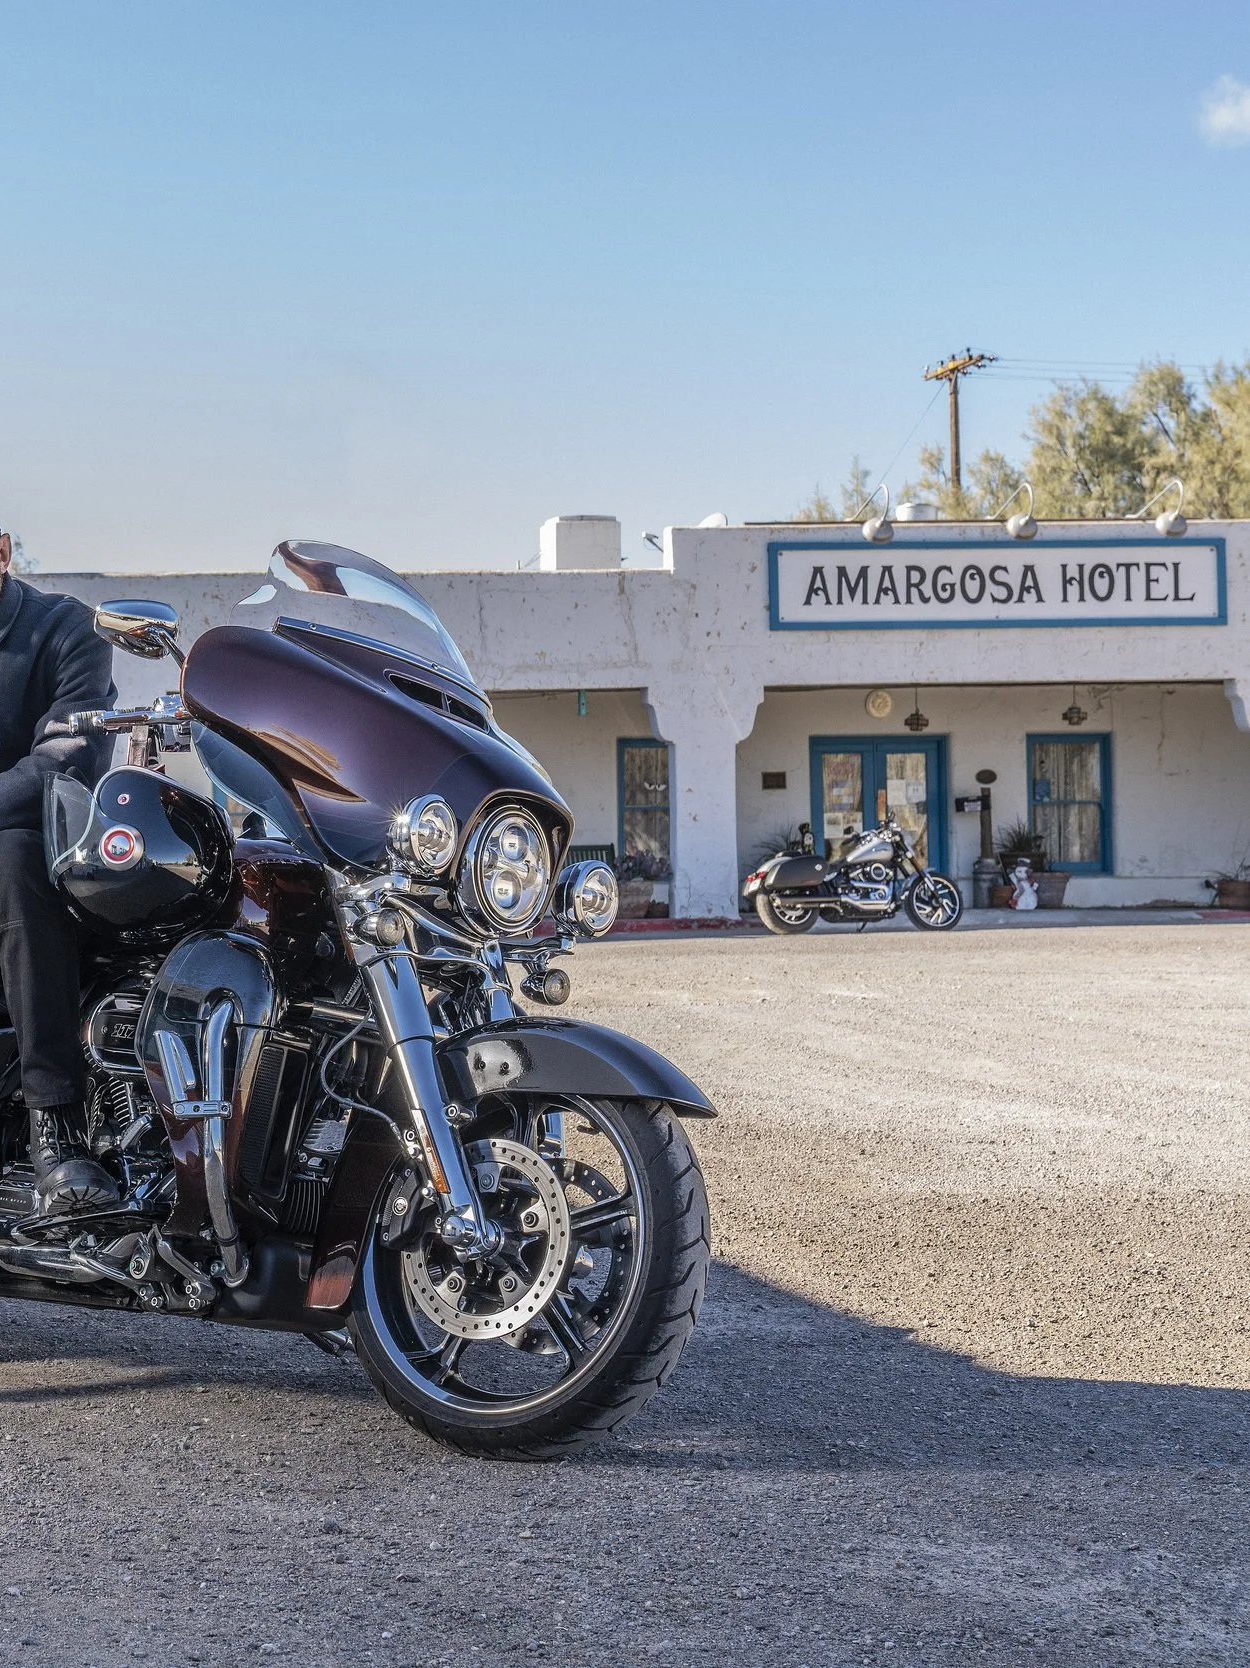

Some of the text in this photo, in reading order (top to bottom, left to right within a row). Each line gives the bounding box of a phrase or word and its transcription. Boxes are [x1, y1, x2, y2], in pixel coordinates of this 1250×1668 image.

[803, 561, 1196, 606] AMARGOSA HOTEL
[111, 1023, 136, 1039] 117
